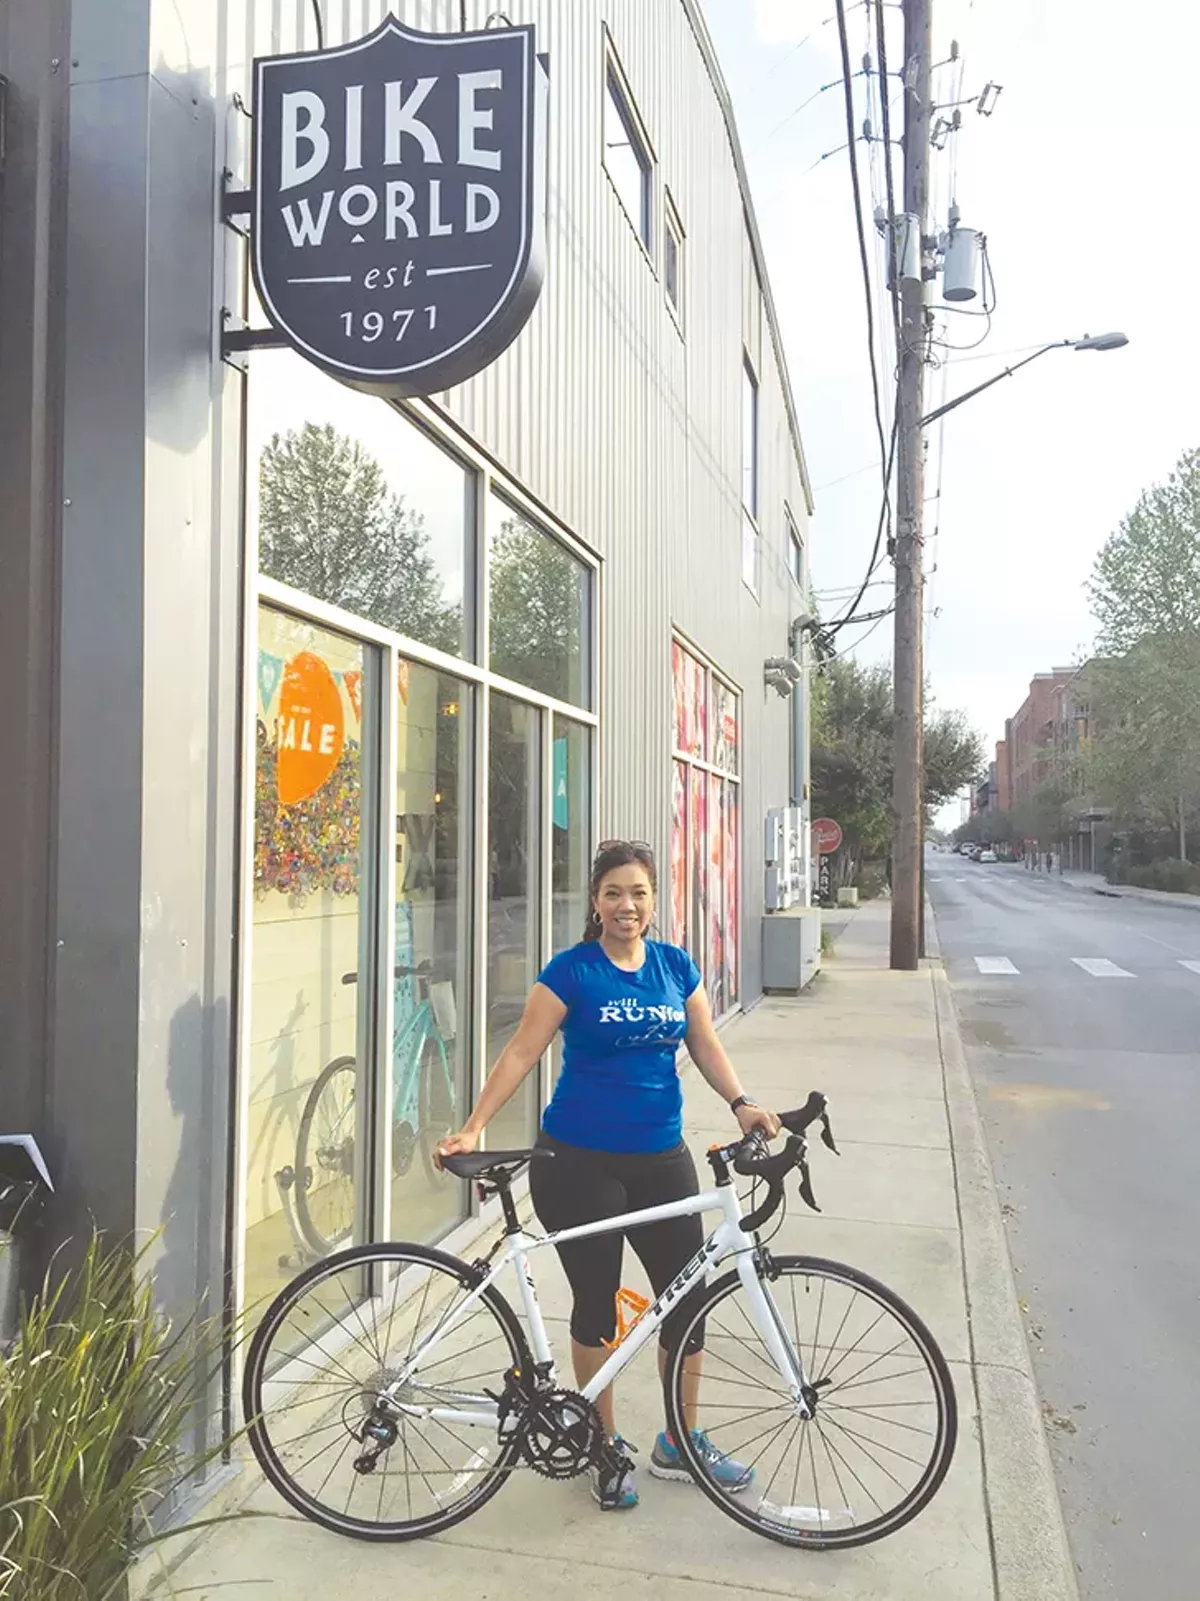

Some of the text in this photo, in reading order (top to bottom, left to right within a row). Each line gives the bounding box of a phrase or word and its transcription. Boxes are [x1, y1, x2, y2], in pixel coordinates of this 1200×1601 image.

[280, 69, 502, 191] BIKE
[281, 180, 500, 247] WORLD
[364, 260, 415, 289] est
[340, 305, 437, 342] 1971
[599, 1005, 667, 1023] RUN
[653, 1236, 719, 1316] TREK
